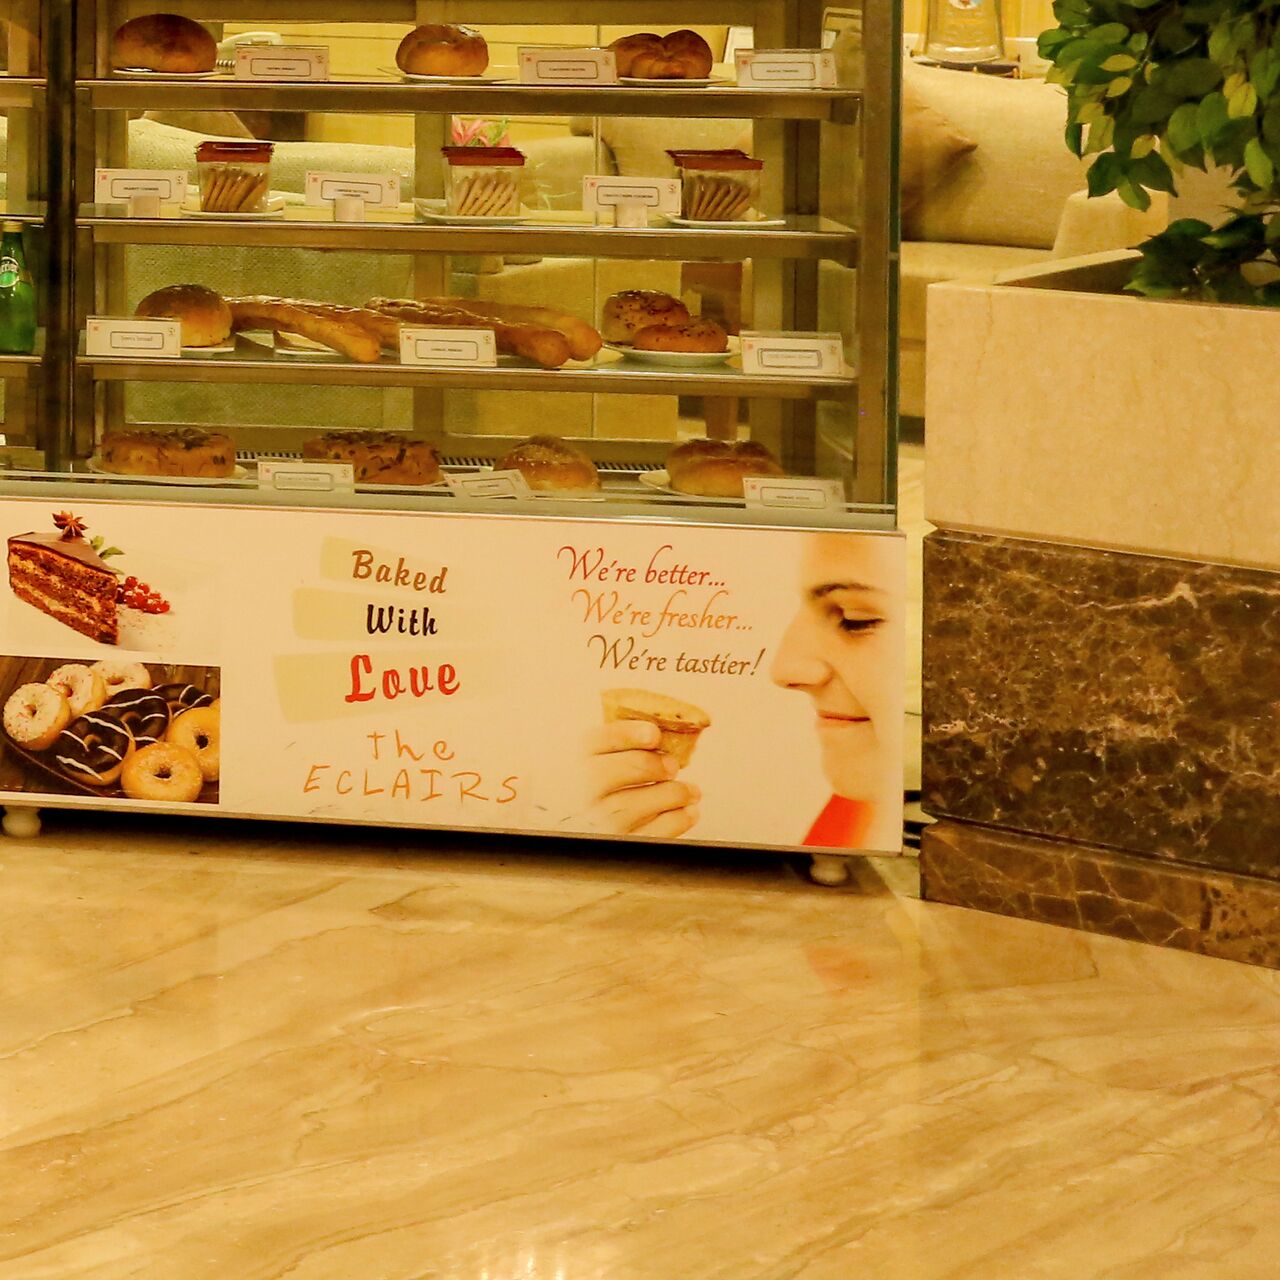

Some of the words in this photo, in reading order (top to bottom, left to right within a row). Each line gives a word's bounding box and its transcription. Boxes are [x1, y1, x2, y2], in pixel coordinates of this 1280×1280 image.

[352, 549, 448, 594] Baked
[644, 545, 726, 587] better...
[366, 604, 438, 636] With
[642, 589, 753, 638] fresher...
[344, 654, 460, 703] Love
[675, 648, 766, 676] tastier!
[303, 765, 519, 804] ECLAIRS
